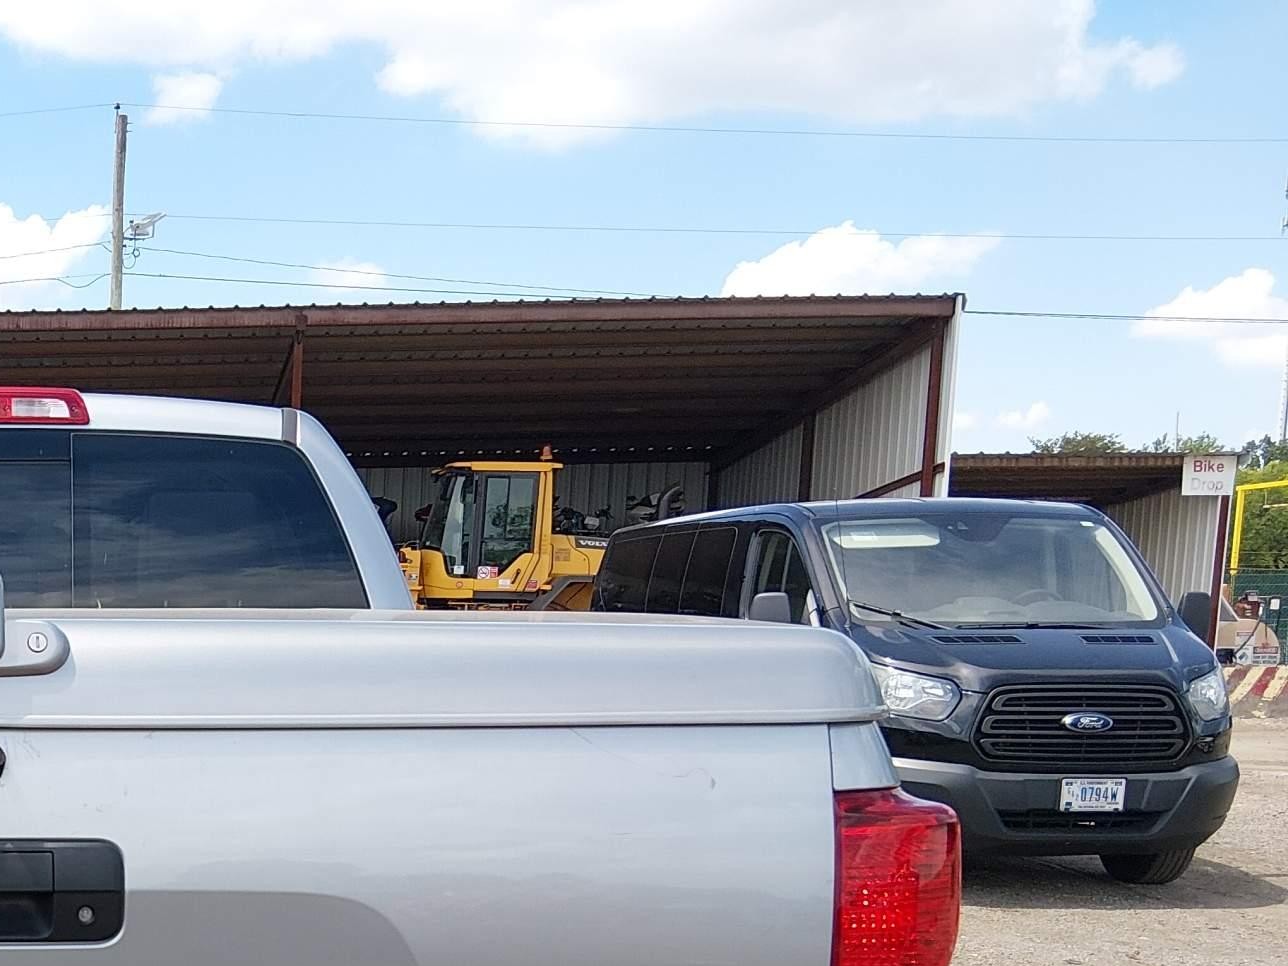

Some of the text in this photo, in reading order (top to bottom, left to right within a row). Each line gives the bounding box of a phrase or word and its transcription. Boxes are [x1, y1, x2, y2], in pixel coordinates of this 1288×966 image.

[1193, 460, 1225, 473] Bike
[1191, 477, 1224, 493] Drop
[1077, 716, 1105, 729] Ford
